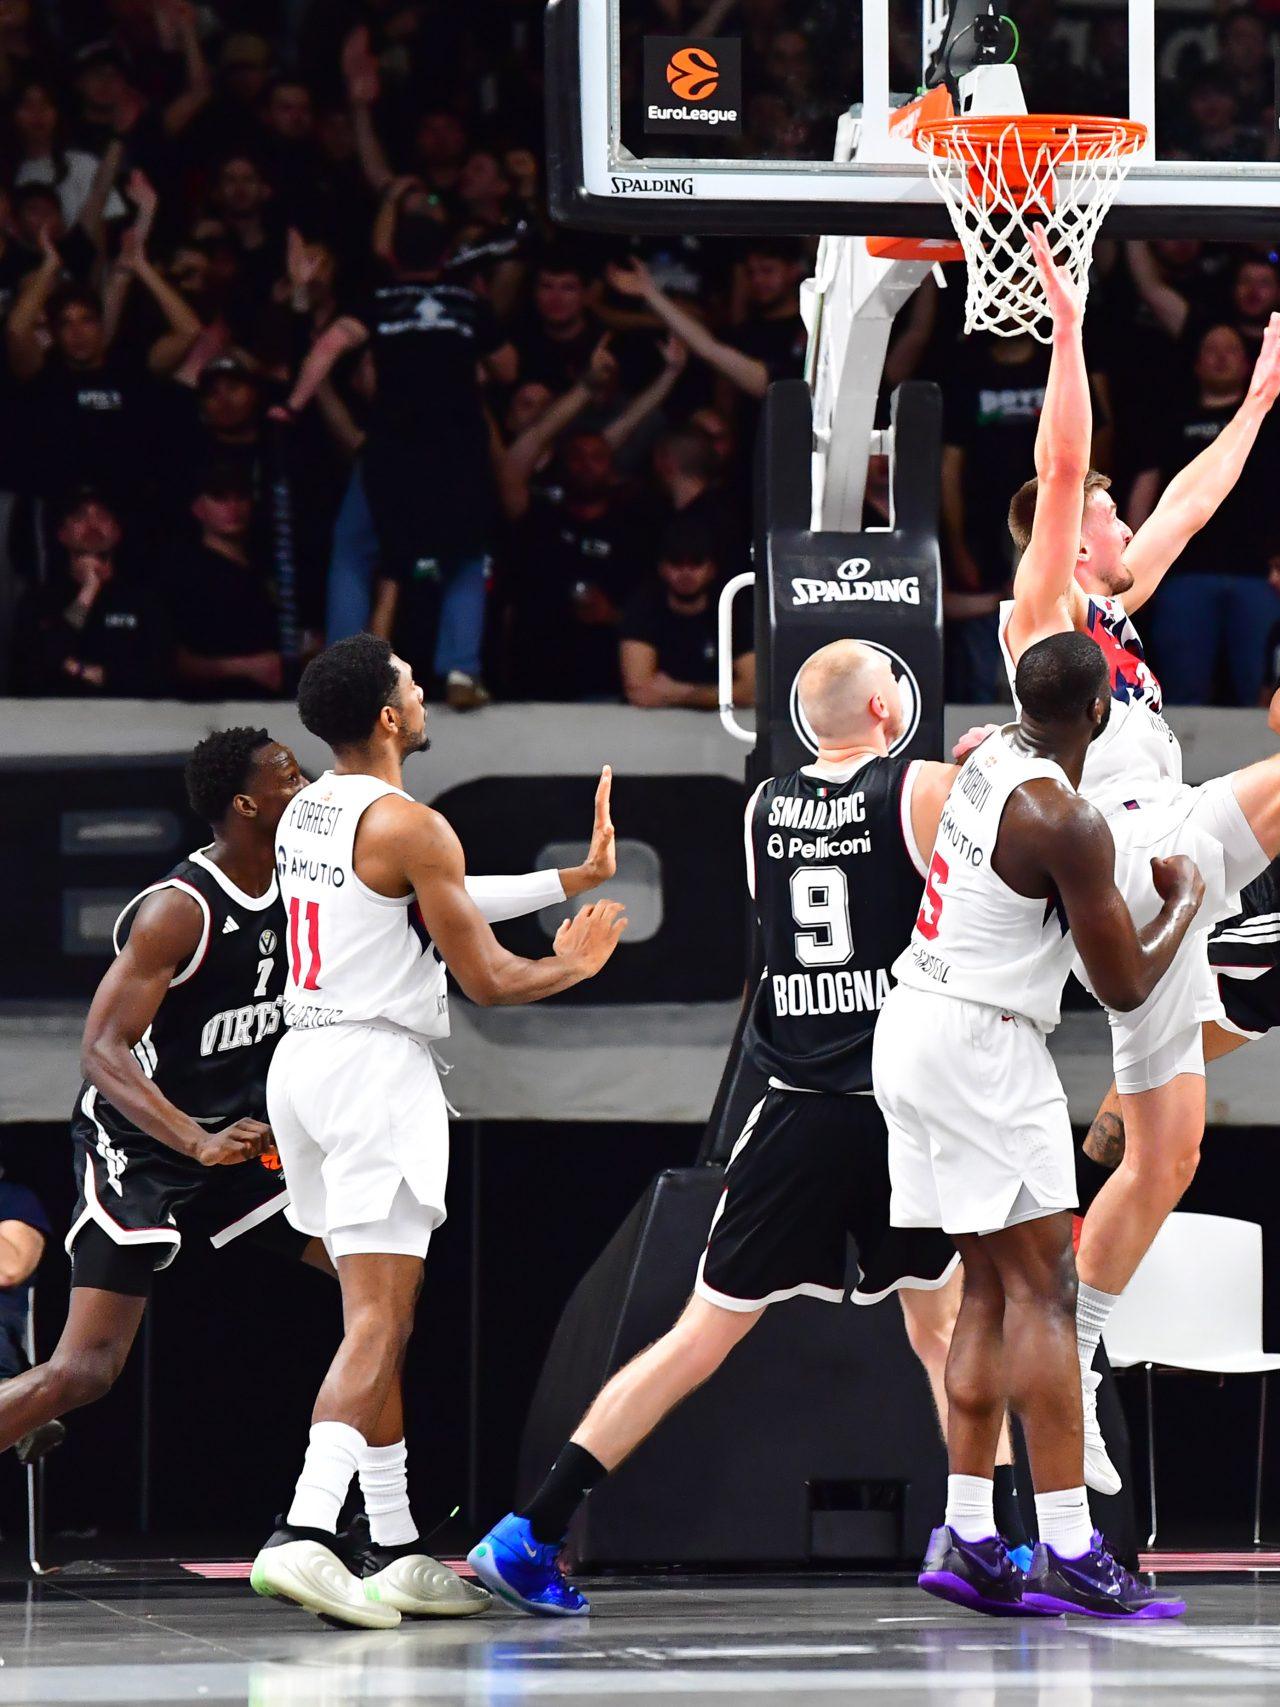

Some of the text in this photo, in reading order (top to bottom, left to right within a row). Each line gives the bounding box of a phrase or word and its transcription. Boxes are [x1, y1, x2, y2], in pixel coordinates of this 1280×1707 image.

[648, 105, 737, 125] EuroLeague
[611, 177, 693, 195] SPALDING
[791, 577, 920, 605] SPALDING
[290, 799, 343, 837] FORREST
[788, 829, 872, 859] Pelliconi
[291, 856, 345, 888] AMUTIO
[916, 850, 950, 941] 5
[789, 865, 855, 968] 9
[289, 897, 323, 991] 11
[772, 968, 892, 1017] BOLOGNA
